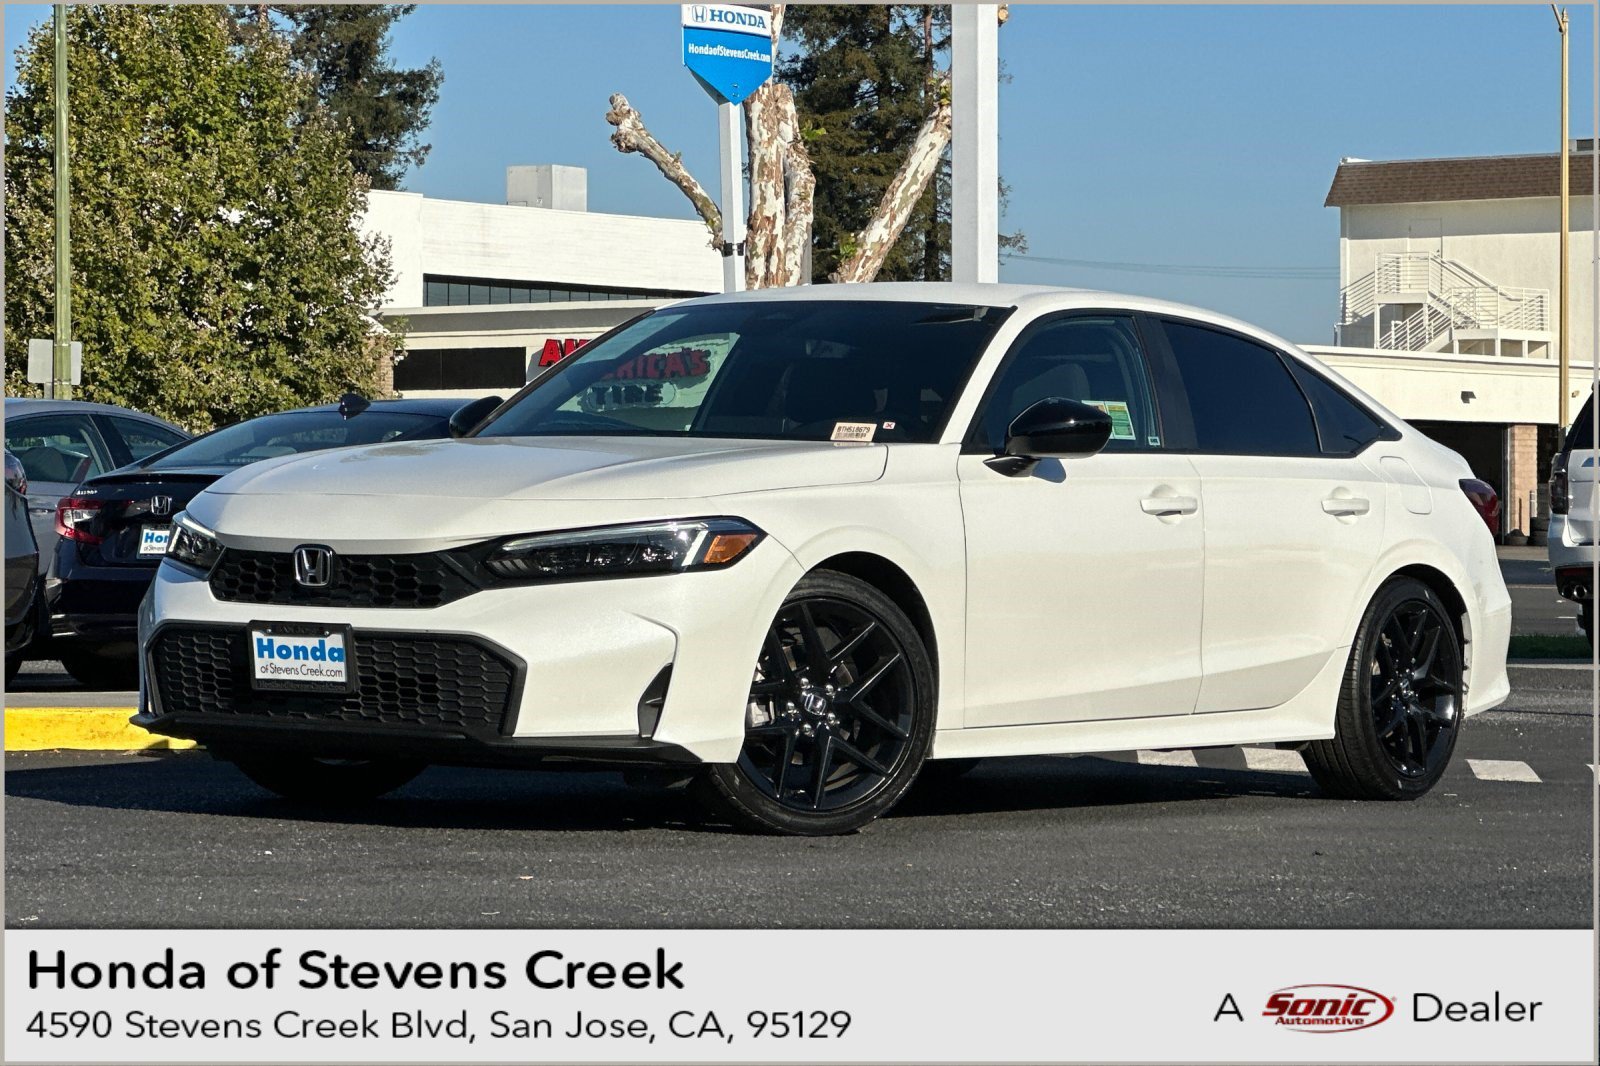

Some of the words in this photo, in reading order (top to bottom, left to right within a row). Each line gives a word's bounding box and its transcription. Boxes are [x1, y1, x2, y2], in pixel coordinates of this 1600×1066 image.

[710, 9, 766, 29] HONDA
[688, 43, 770, 62] HondaofStevensCreek.com
[256, 638, 344, 662] Honda
[260, 665, 269, 674] of
[269, 663, 299, 675] Stevens
[300, 664, 342, 677] Creek.com
